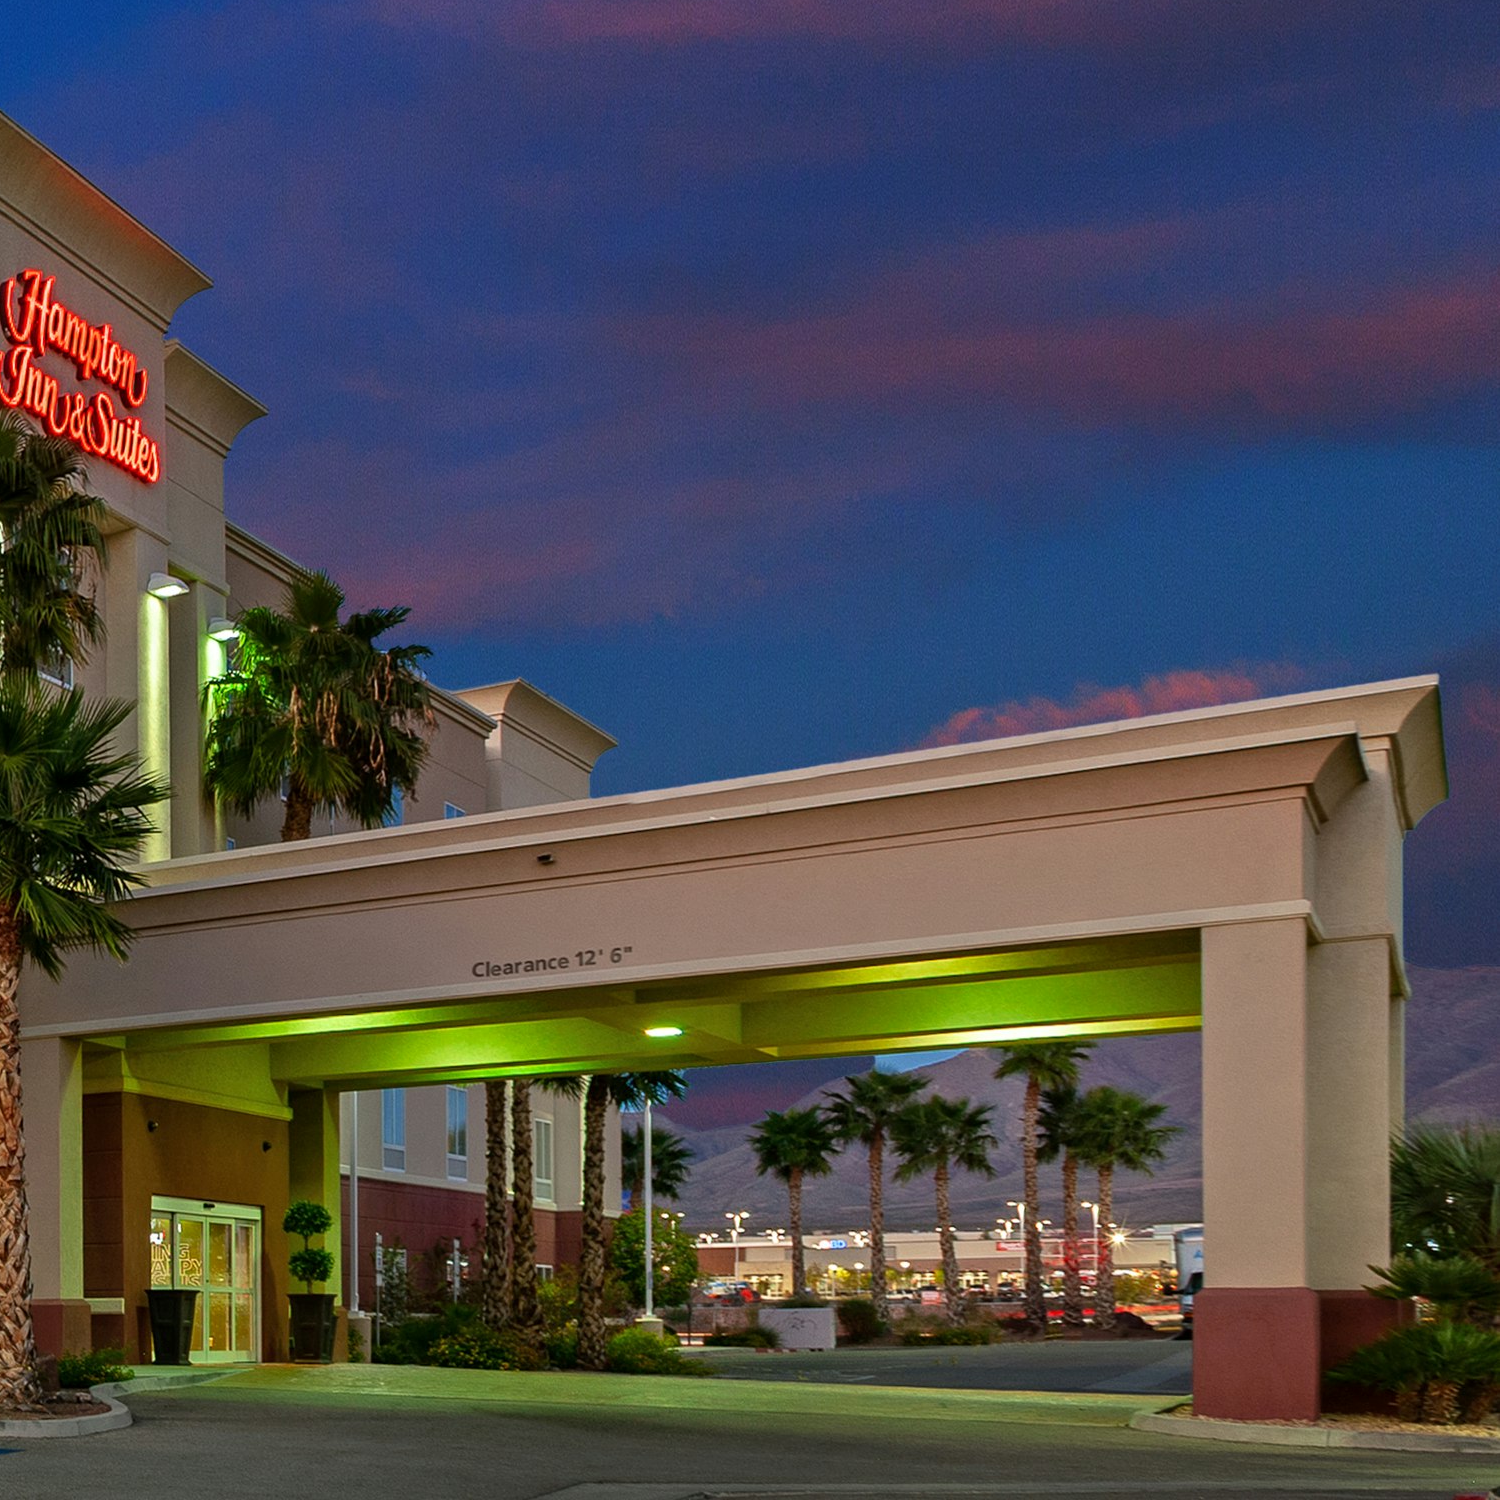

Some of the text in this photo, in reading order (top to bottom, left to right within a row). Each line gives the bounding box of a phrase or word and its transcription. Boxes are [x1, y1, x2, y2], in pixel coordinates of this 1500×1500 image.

[0, 269, 148, 408] Hampton
[86, 392, 161, 484] Suites
[472, 946, 633, 978] Clearance 12' 6"
